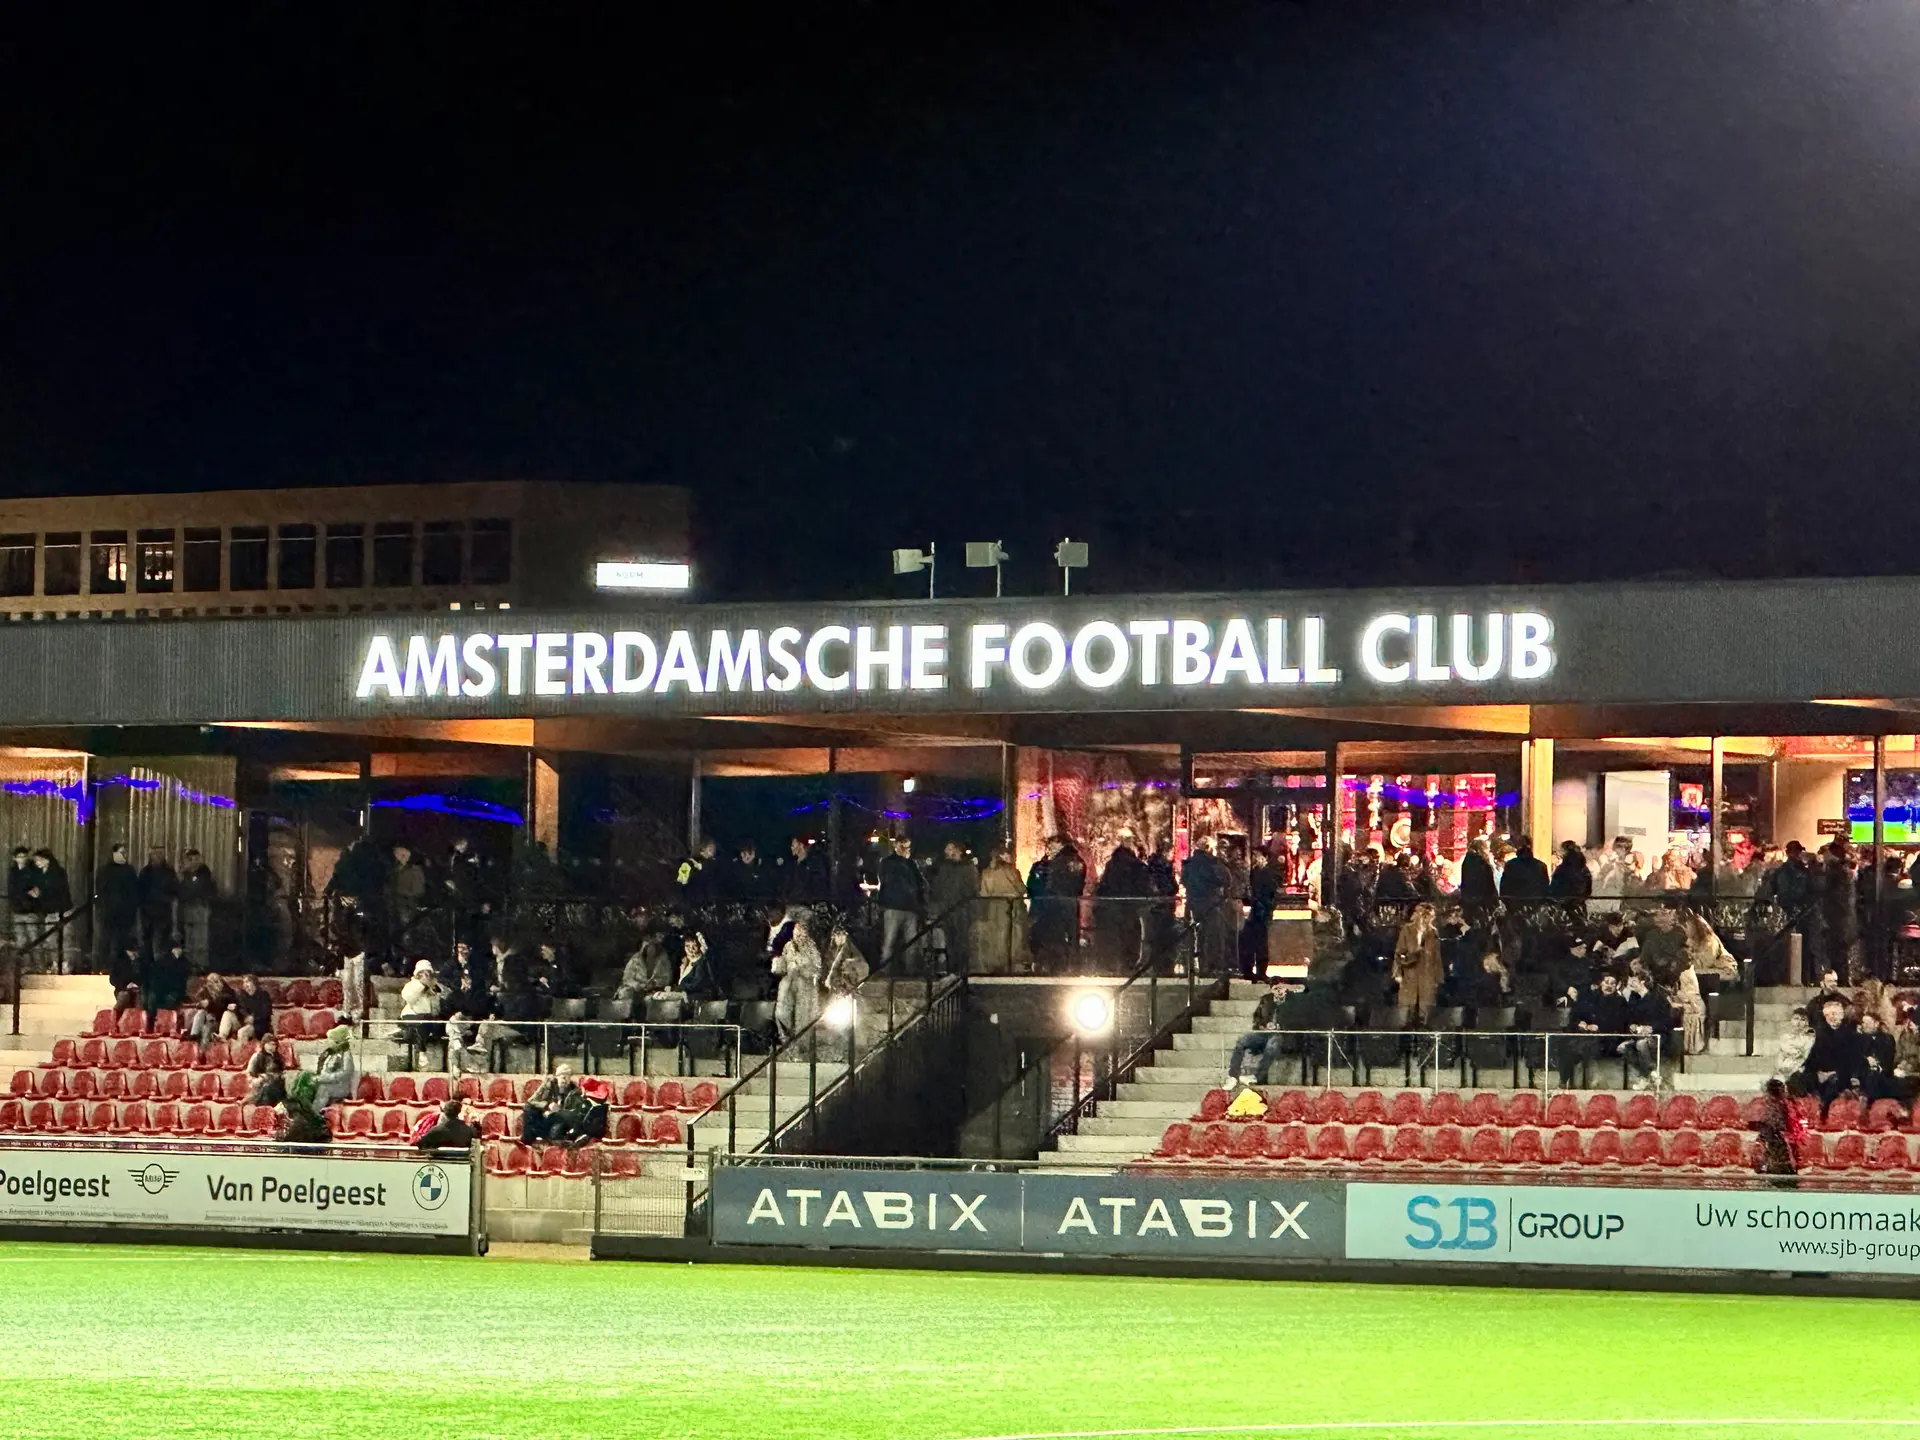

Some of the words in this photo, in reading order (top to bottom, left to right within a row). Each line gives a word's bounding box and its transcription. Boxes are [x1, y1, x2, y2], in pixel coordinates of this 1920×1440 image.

[356, 625, 946, 697] AMSTERDAMSCHE
[971, 616, 1341, 689] FOOTBALL
[1361, 612, 1554, 684] CLUB
[206, 1174, 253, 1201] Van
[262, 1176, 387, 1210] Poelgeest
[747, 1188, 988, 1232] ATABIX
[1057, 1197, 1310, 1239] ATABIX
[1405, 1195, 1498, 1250] SJB
[1518, 1212, 1625, 1240] GROUP
[1696, 1203, 1738, 1227] Uw
[1746, 1205, 1920, 1232] schoonmaak
[1778, 1239, 1920, 1260] www.sjb-group
